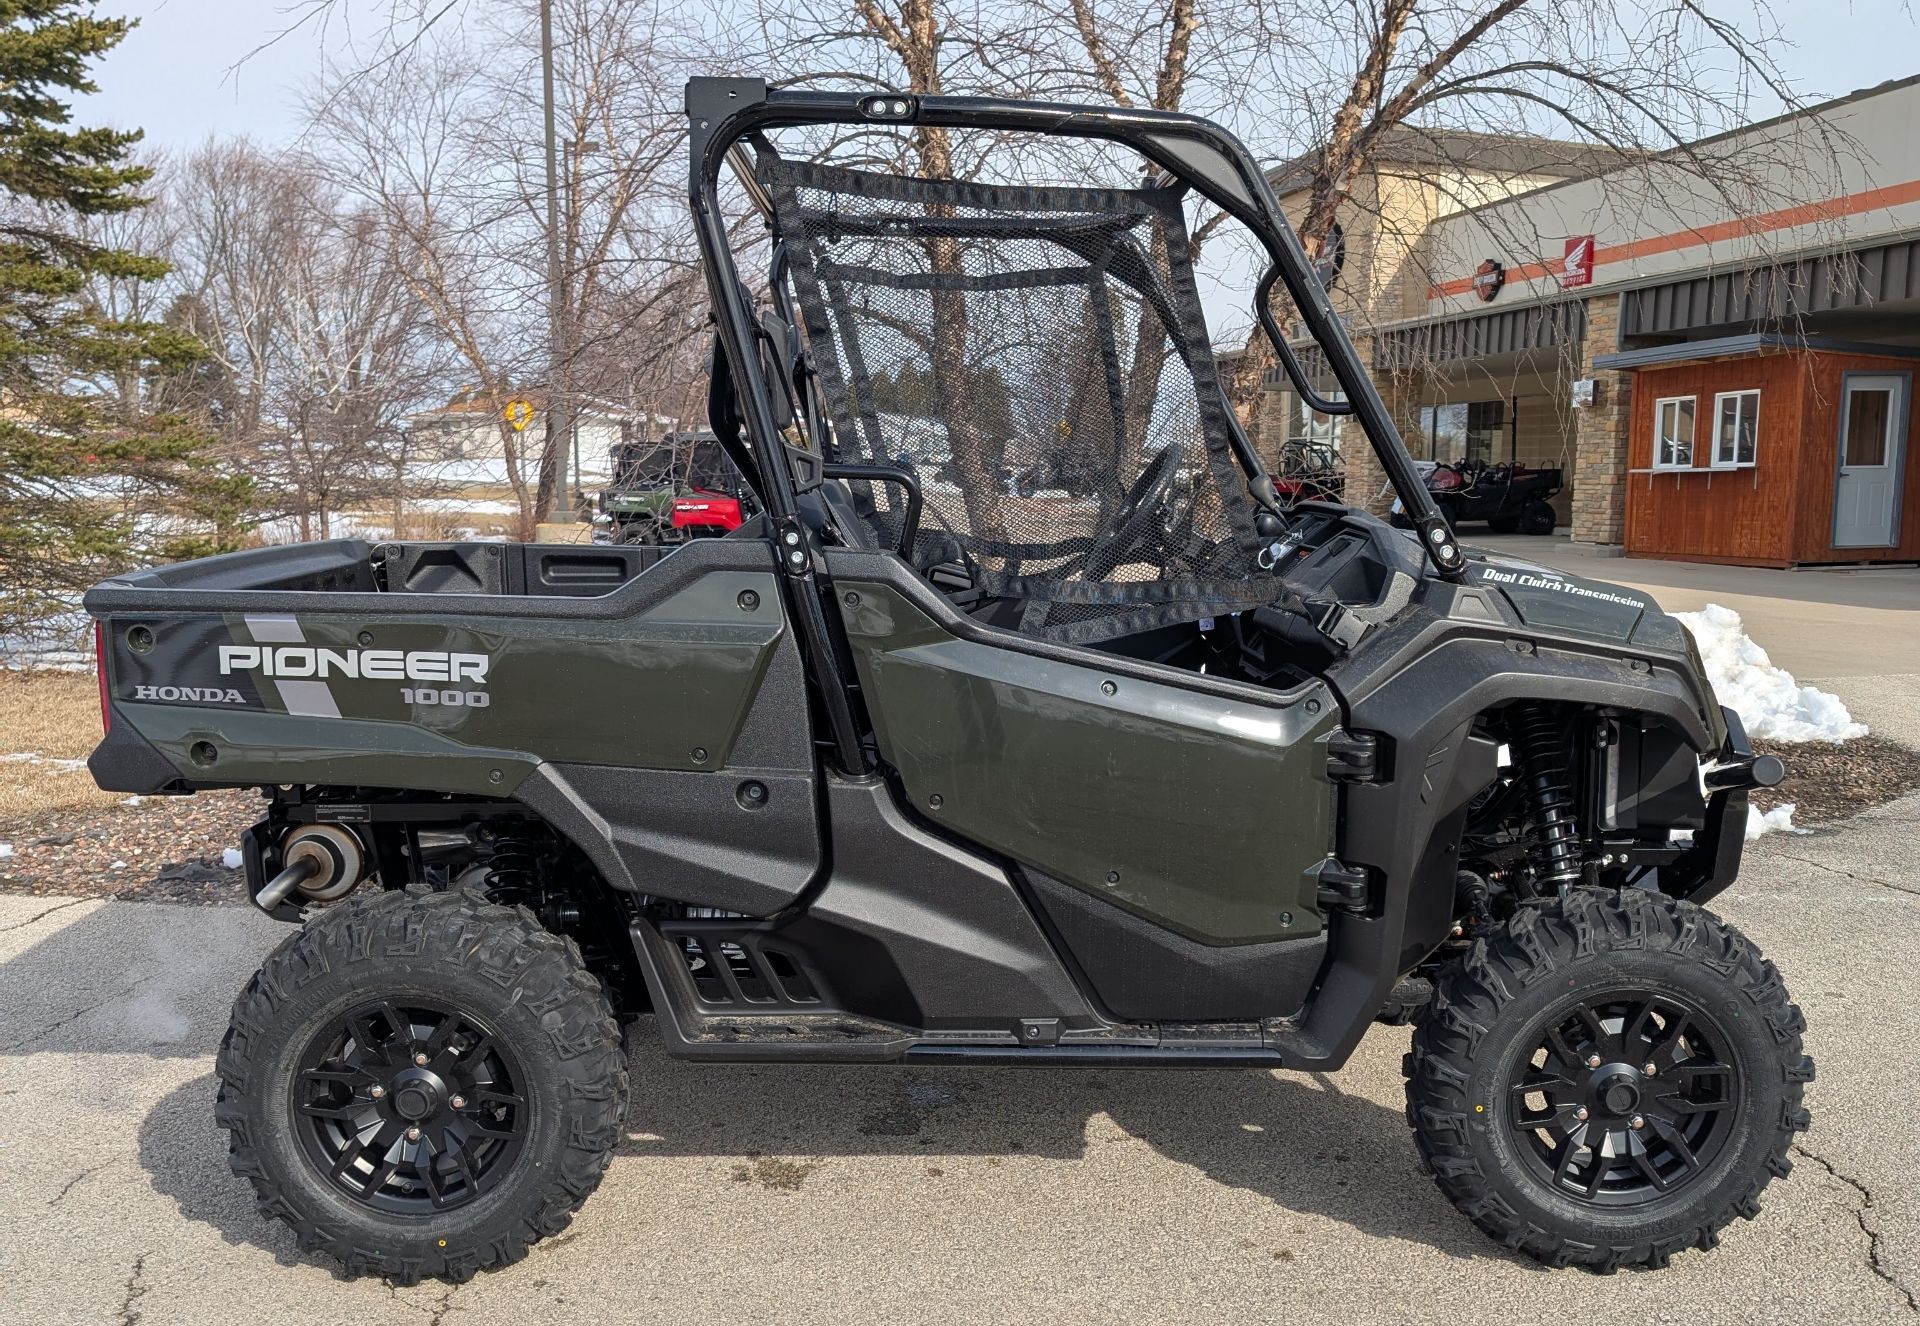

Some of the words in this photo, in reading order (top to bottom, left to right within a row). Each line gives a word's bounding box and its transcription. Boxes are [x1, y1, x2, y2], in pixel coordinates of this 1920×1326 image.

[1483, 568, 1517, 583] Dual
[1518, 575, 1561, 591] Clutch
[1564, 583, 1645, 609] Transmission
[218, 645, 489, 684] PIONEER
[134, 685, 247, 704] HONDA
[400, 688, 490, 707] 1000
